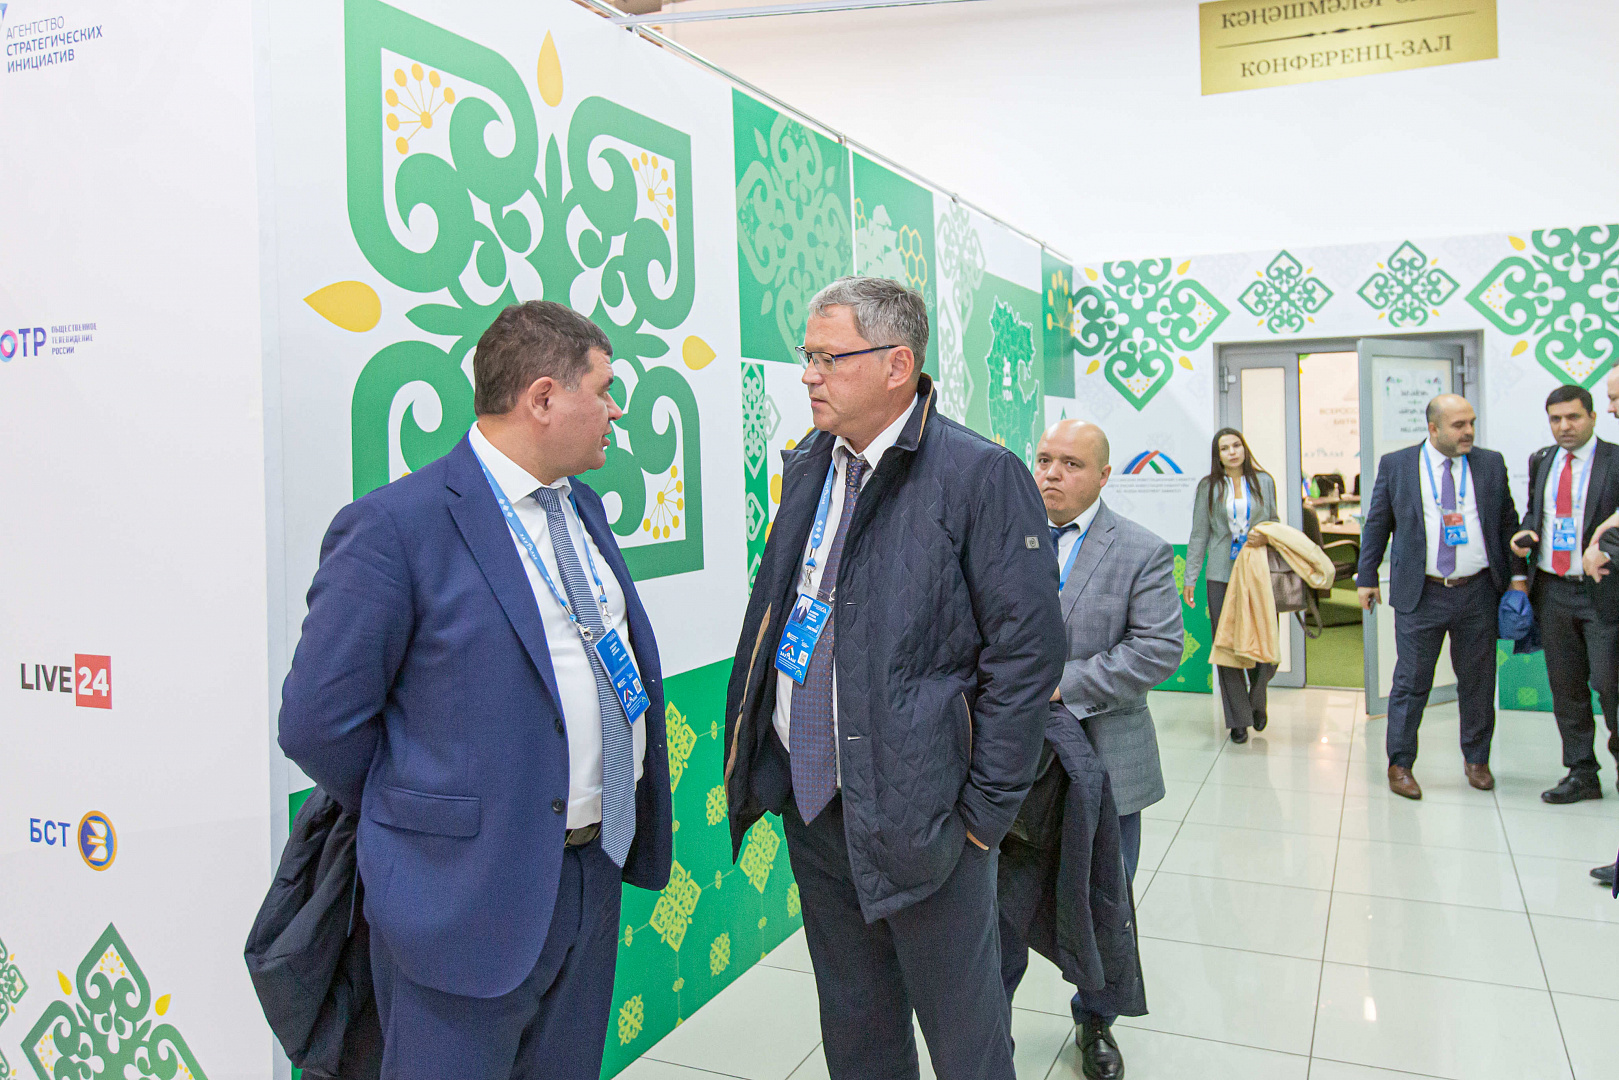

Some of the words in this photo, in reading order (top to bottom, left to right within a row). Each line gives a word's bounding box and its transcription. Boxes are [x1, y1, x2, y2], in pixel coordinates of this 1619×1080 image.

[6, 15, 65, 40] АГЕНТСТВО
[6, 25, 103, 57] СТРАТЕГИЧЕСКИХ
[7, 48, 75, 73] ИНИЦИАТИВ
[1241, 34, 1452, 78] КОНФЕРЕНЦ-ЗАЛ
[51, 346, 75, 355] РОССИИ
[29, 817, 71, 847] БСТ
